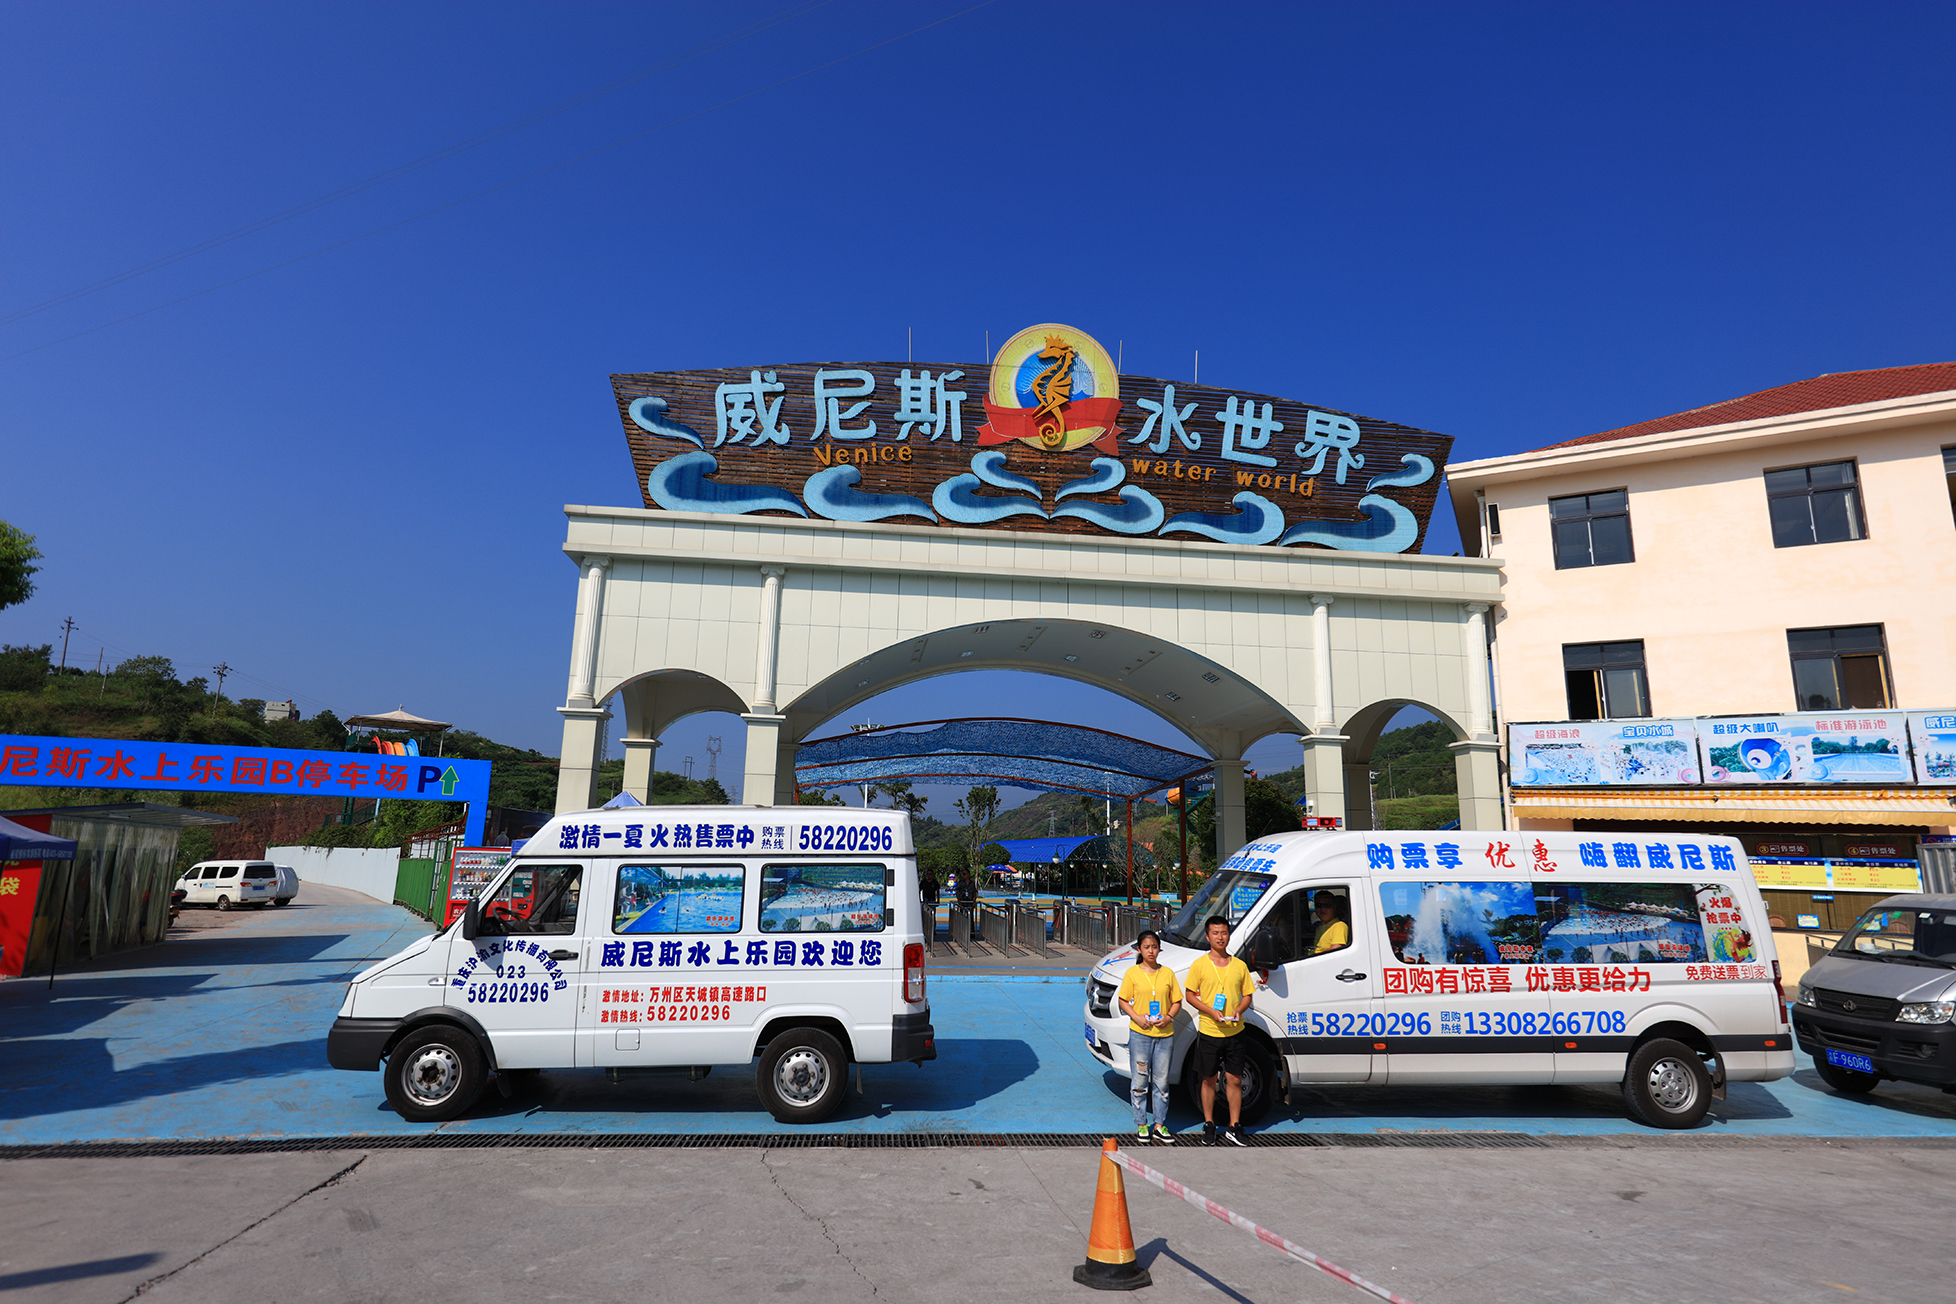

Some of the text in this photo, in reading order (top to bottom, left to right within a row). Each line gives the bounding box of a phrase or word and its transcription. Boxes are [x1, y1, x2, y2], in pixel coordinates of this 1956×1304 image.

[714, 368, 1365, 485] 威尼斯 水世界
[814, 442, 1315, 497] Venice water world
[1534, 729, 1581, 739] 超级海浪
[1622, 725, 1674, 738] 宝贝水城
[1712, 722, 1780, 735] 超级大喇叭
[1815, 719, 1888, 731] 标准游泳池
[799, 825, 892, 851] 58220296
[1366, 842, 1464, 870] 购票享
[1484, 838, 1558, 873] 优惠
[1578, 842, 1737, 872] 嗨翻威尼斯
[1709, 897, 1733, 909] 火爆
[601, 940, 882, 967] 威尼斯水上乐园欢迎您
[496, 965, 526, 979] 023
[1382, 966, 1651, 994] 团购有惊喜 优惠更给力
[1685, 964, 1768, 981] 免费送票到家
[468, 983, 550, 1004] 58220296
[1311, 1012, 1432, 1036] 58220296
[1464, 1010, 1626, 1035] 13308266708
